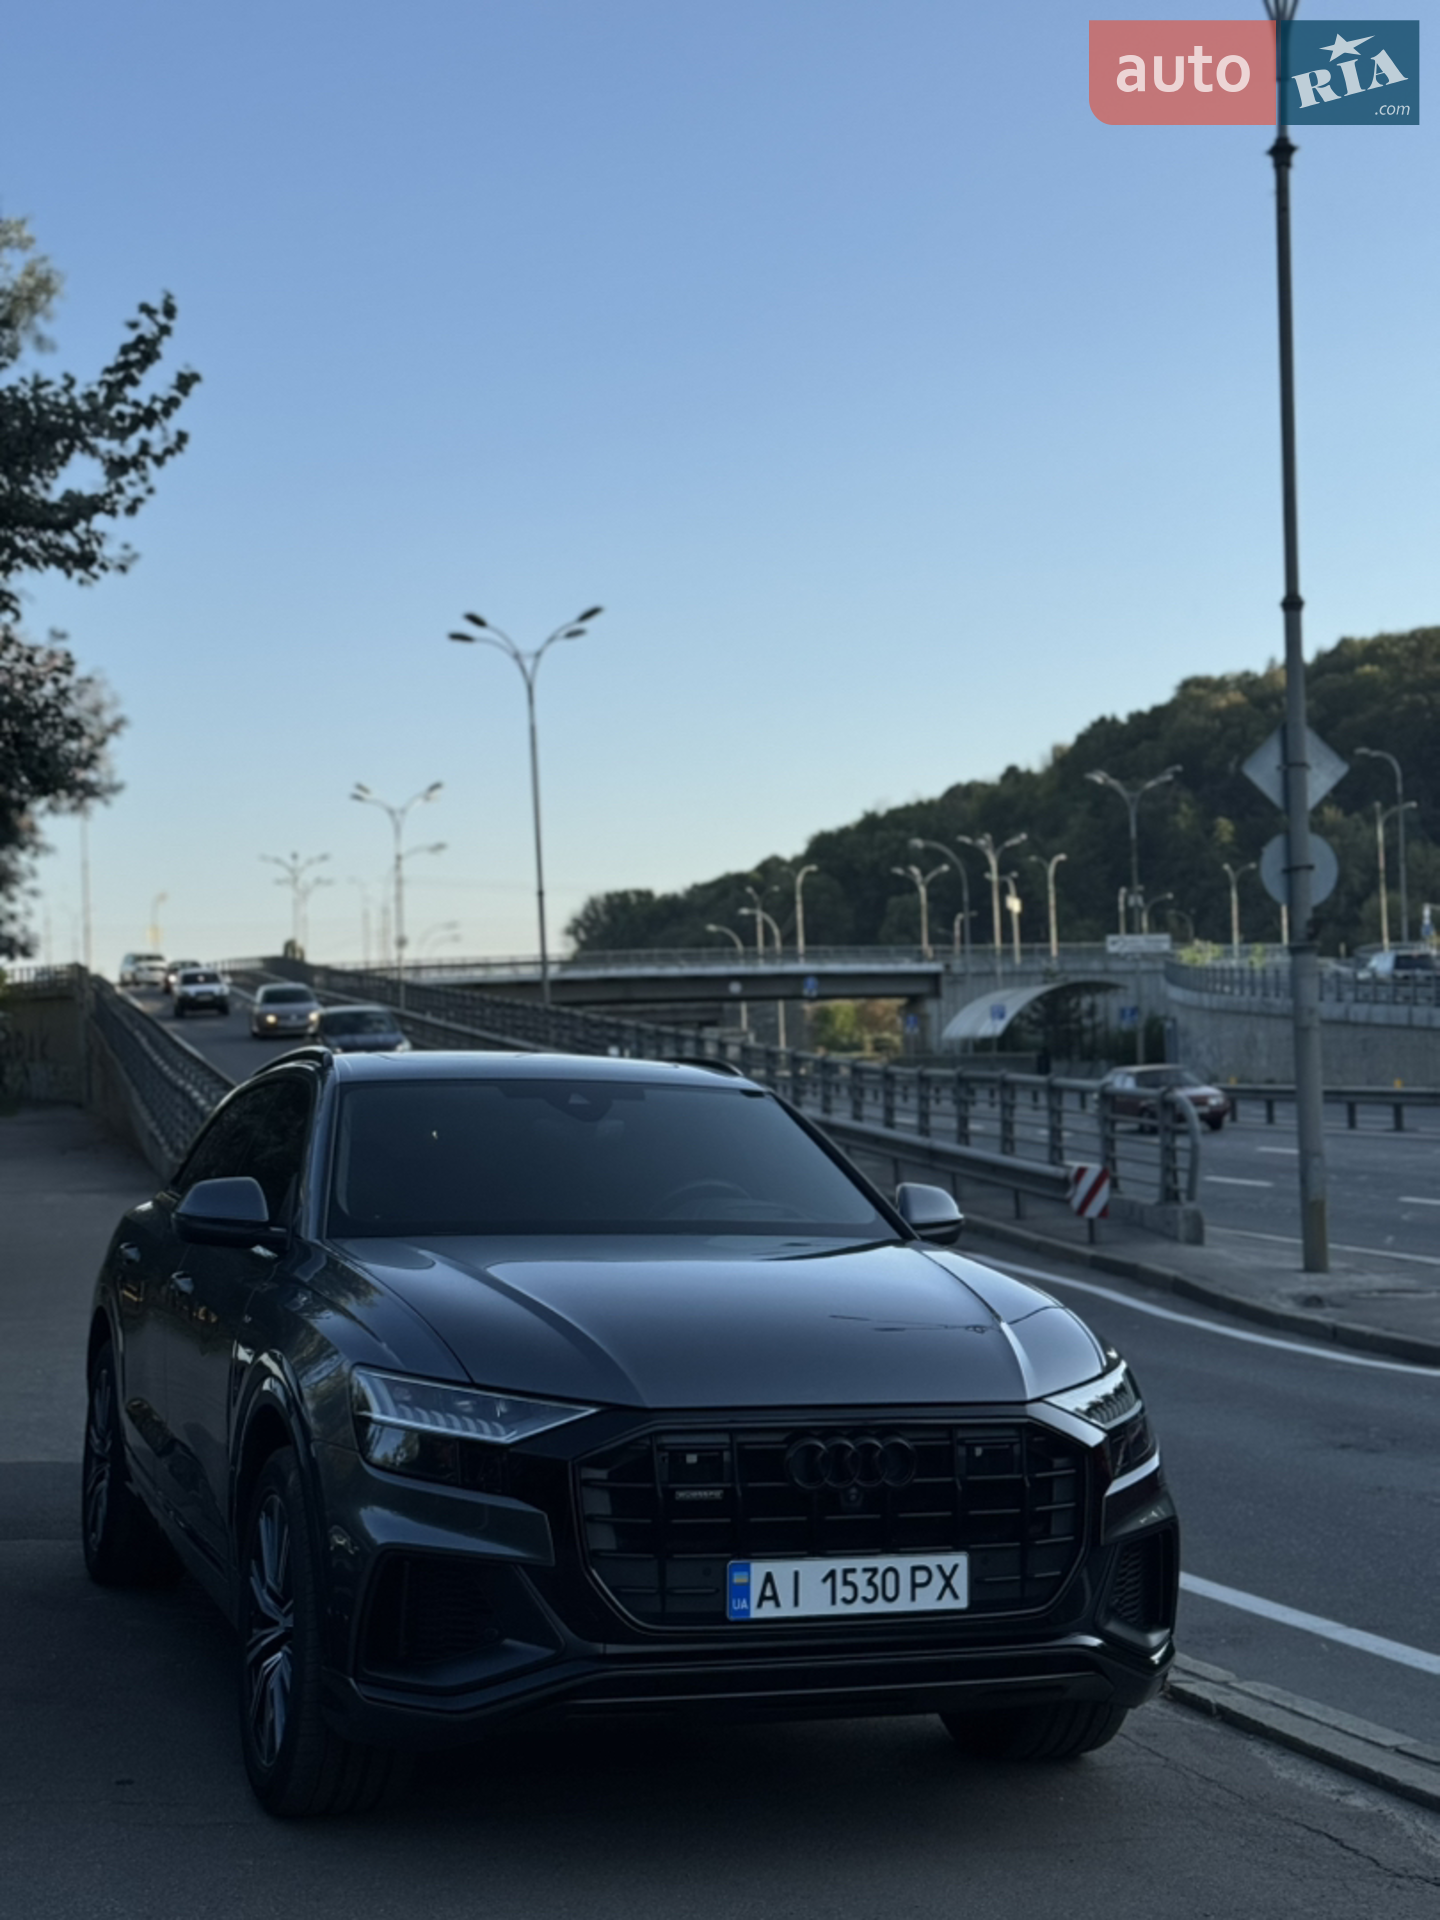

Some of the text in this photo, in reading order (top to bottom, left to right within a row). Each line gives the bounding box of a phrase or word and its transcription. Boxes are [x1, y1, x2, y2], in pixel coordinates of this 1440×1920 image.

[756, 1563, 960, 1609] AI 1530 PX
[732, 1598, 749, 1611] UA
